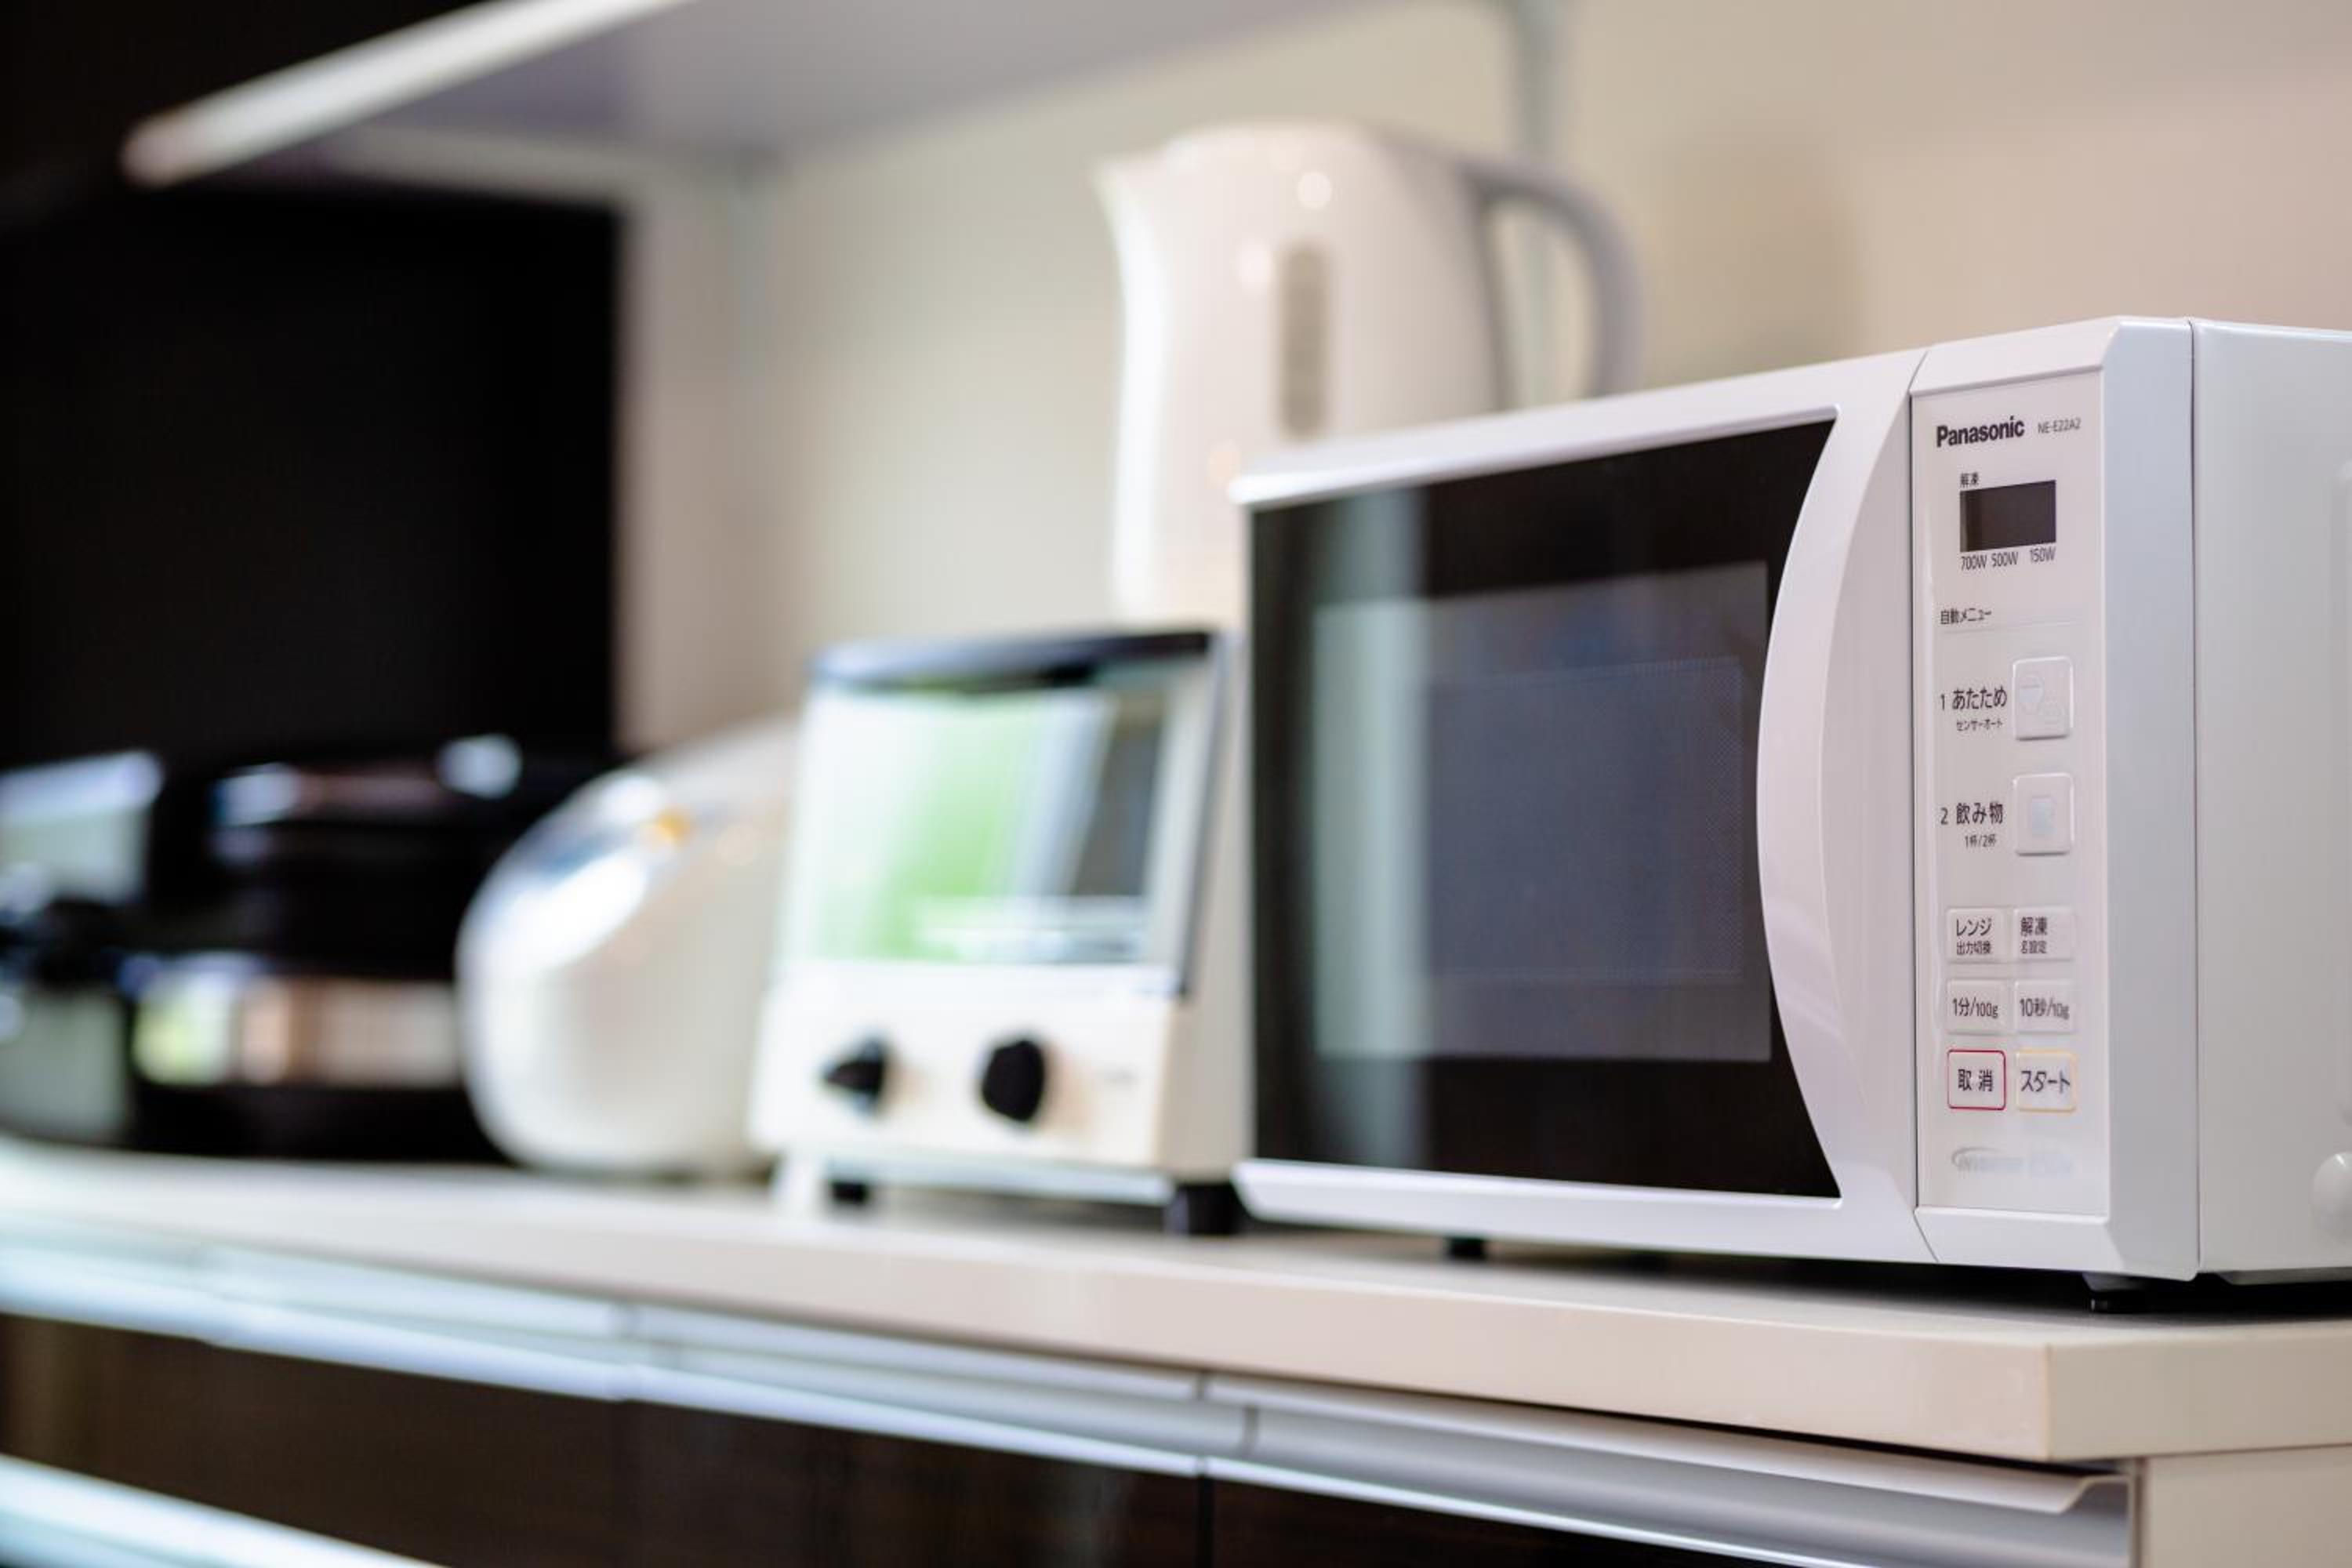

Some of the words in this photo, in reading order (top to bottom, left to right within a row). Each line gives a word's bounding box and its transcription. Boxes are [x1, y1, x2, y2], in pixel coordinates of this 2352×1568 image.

[1936, 416, 2024, 448] Panasonic
[2038, 417, 2081, 434] NE-E22A2
[1960, 472, 1979, 488] 解凍
[1960, 554, 1987, 571] 700W
[1991, 551, 2019, 568] 500W
[2029, 546, 2056, 563] 150W
[1940, 608, 1991, 625] 自動メニュー
[1940, 694, 1945, 710] 1
[1952, 686, 2007, 710] あたため
[1940, 808, 1948, 825] 2
[1956, 802, 2003, 825] 飲み物
[1957, 918, 1991, 938] レンジ
[2020, 916, 2047, 937] 解凍
[1957, 941, 1991, 955] 出力切換
[1952, 996, 1998, 1019] 1分/100g
[2020, 998, 2070, 1020] 10秒/10g
[1958, 1069, 1993, 1091] 取消
[2021, 1070, 2071, 1093] スタート
